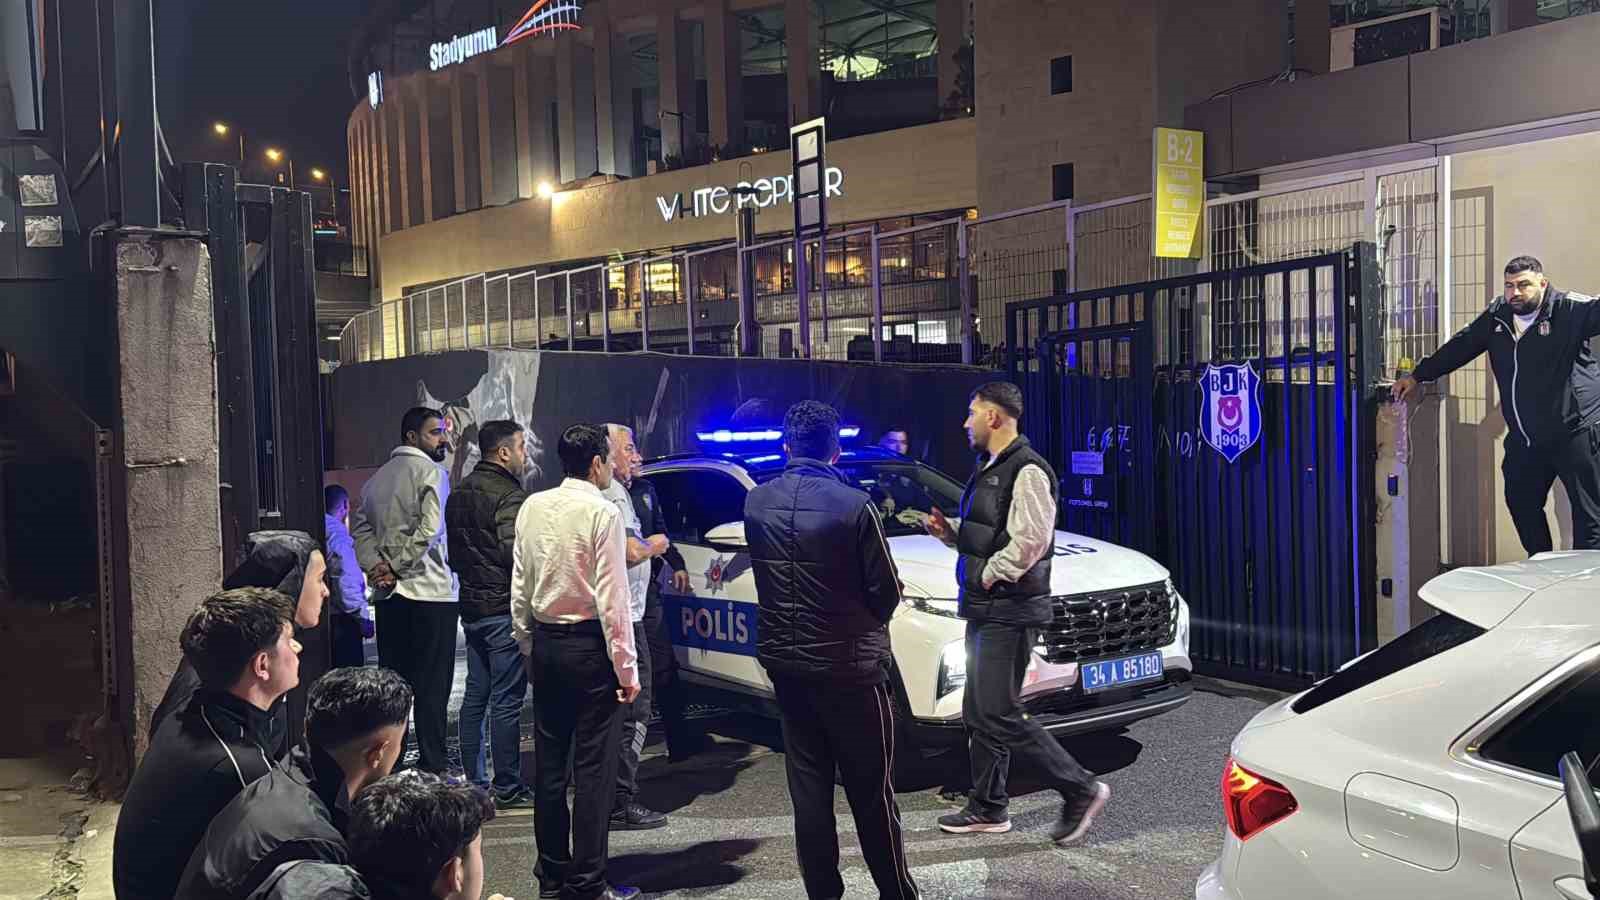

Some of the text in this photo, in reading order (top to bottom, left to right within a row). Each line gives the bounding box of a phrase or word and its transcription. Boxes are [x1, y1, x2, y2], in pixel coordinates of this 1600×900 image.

[429, 26, 497, 71] Stadyumu
[1210, 372, 1248, 392] BJK
[1215, 433, 1248, 447] 1903
[680, 601, 749, 644] POLİS
[1090, 655, 1159, 685] 34 A 85180
